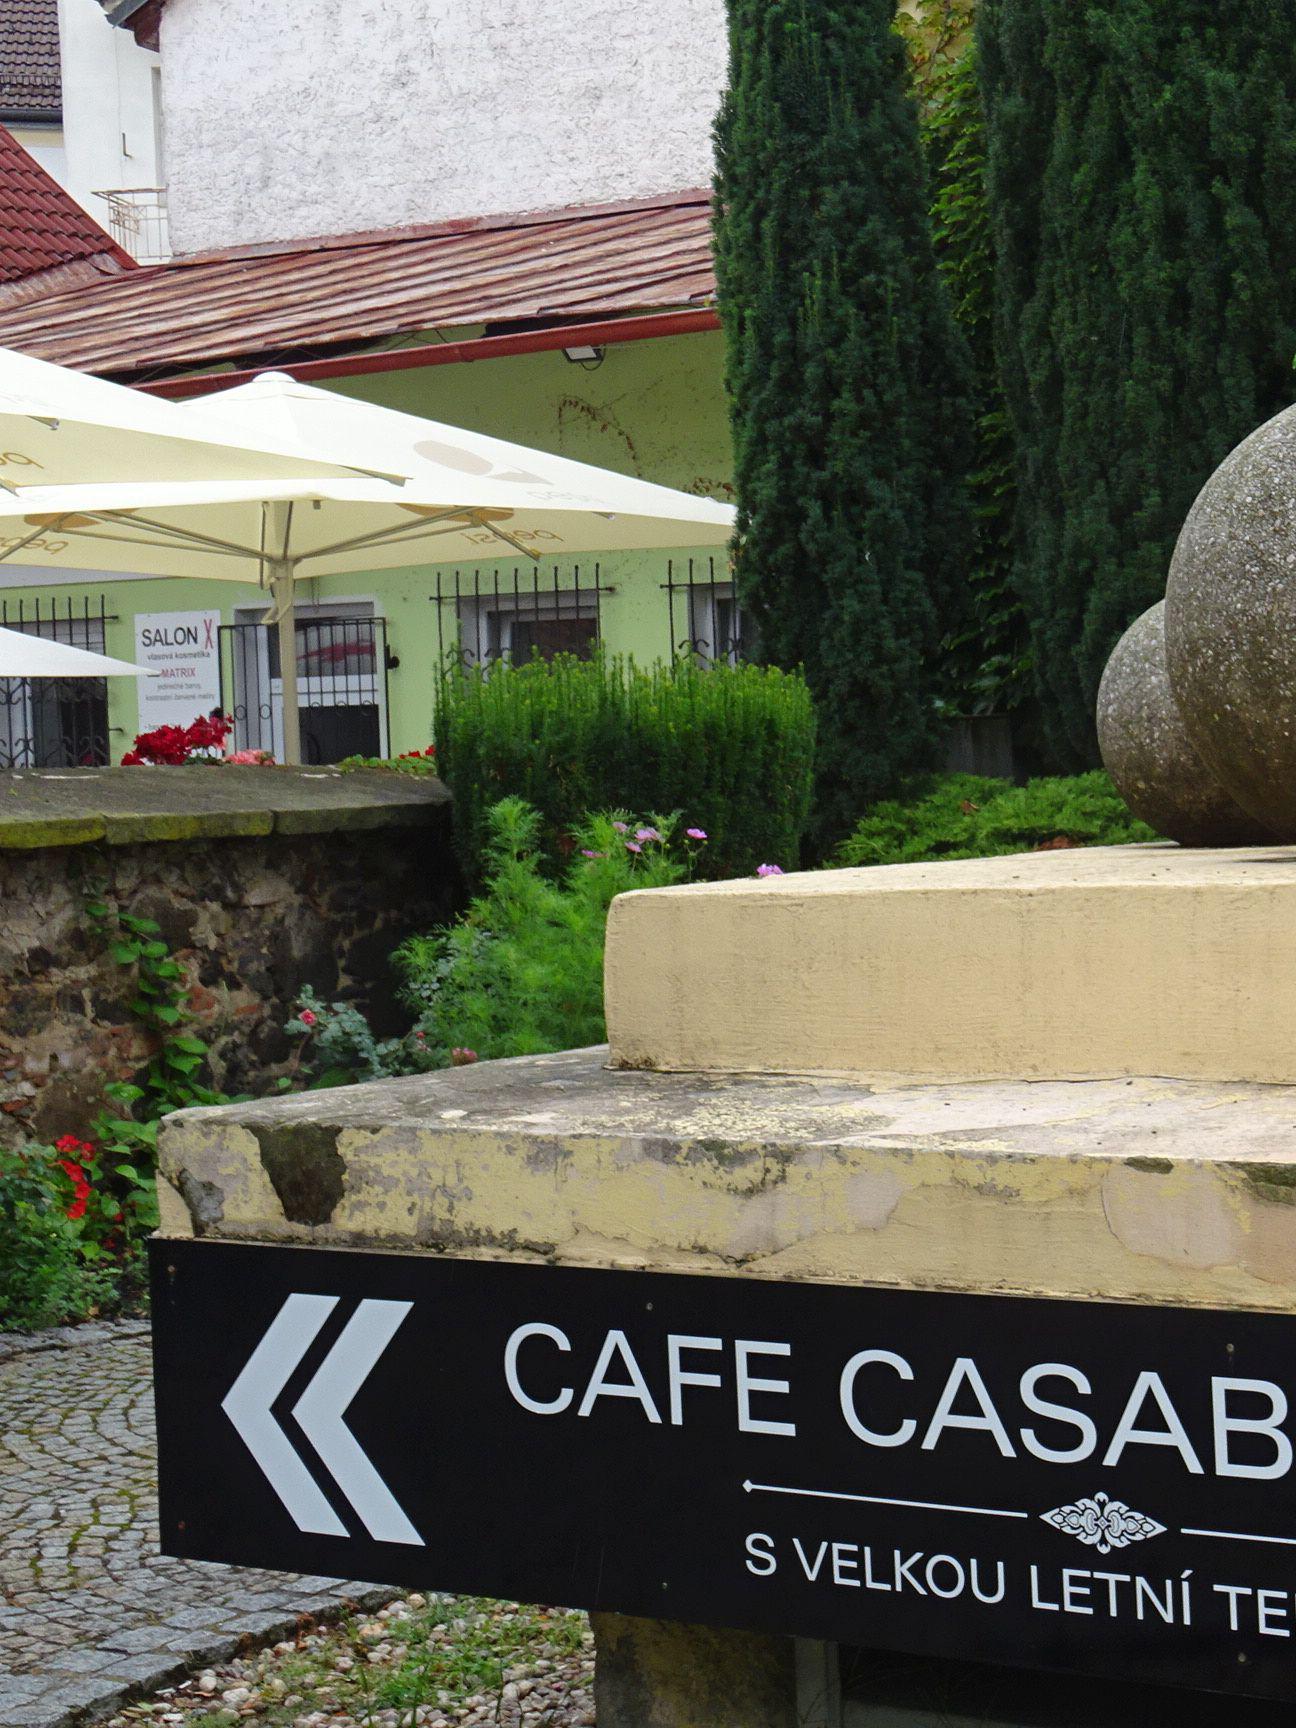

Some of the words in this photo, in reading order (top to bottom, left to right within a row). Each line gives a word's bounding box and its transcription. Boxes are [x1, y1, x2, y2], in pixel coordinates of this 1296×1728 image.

[142, 625, 198, 648] SALON
[175, 650, 211, 660] kosmetika
[161, 667, 196, 678] MATRIX
[504, 1322, 796, 1437] CAFE
[745, 1533, 777, 1576] S
[792, 1537, 1006, 1604] VELKOU
[1030, 1564, 1192, 1626] LETNÍ
